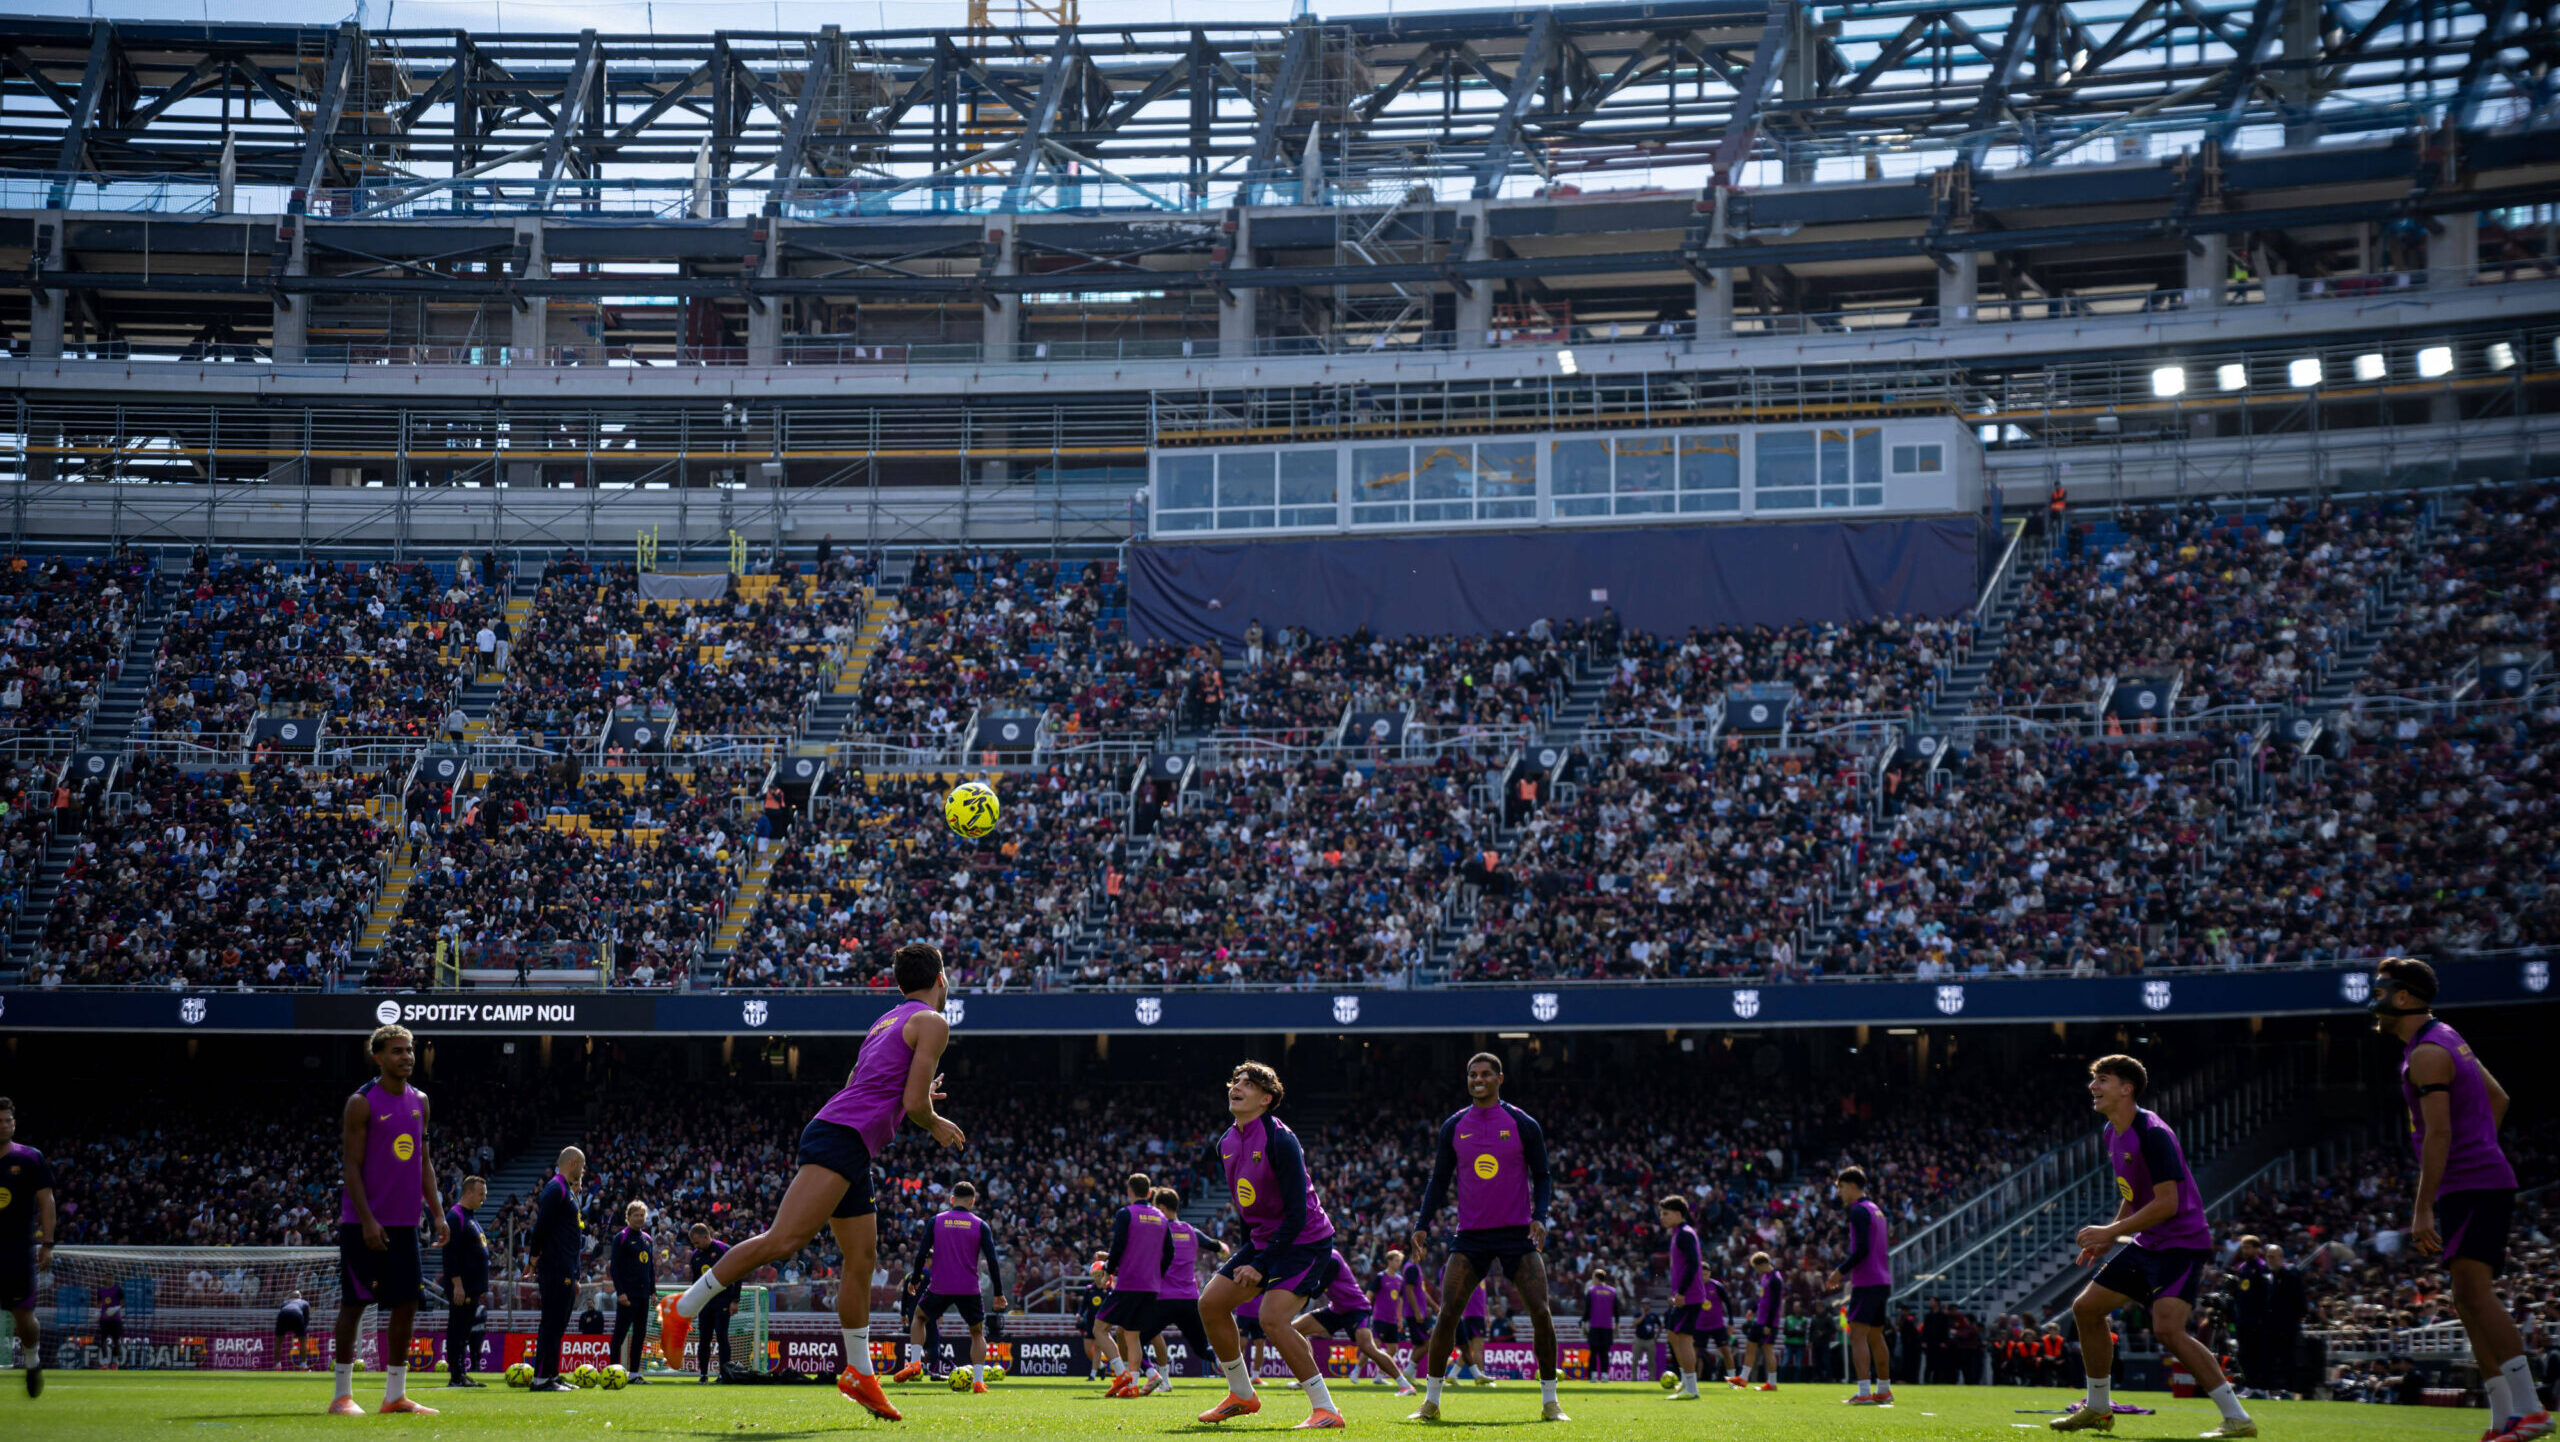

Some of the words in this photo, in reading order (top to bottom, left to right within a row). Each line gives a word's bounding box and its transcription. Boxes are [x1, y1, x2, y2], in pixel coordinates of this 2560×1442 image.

[404, 1005, 478, 1021] SPOTIFY
[482, 1005, 533, 1021] CAMP
[538, 1005, 574, 1021] NOU
[215, 1338, 263, 1355] BARÇA
[562, 1341, 611, 1357] BARÇA
[789, 1342, 838, 1359] BARÇA
[1021, 1344, 1071, 1361] BARÇA
[215, 1353, 260, 1368] Mobile
[788, 1357, 834, 1372] Mobile
[1484, 1349, 1534, 1366] BARÇA
[1020, 1359, 1067, 1374] Mobile
